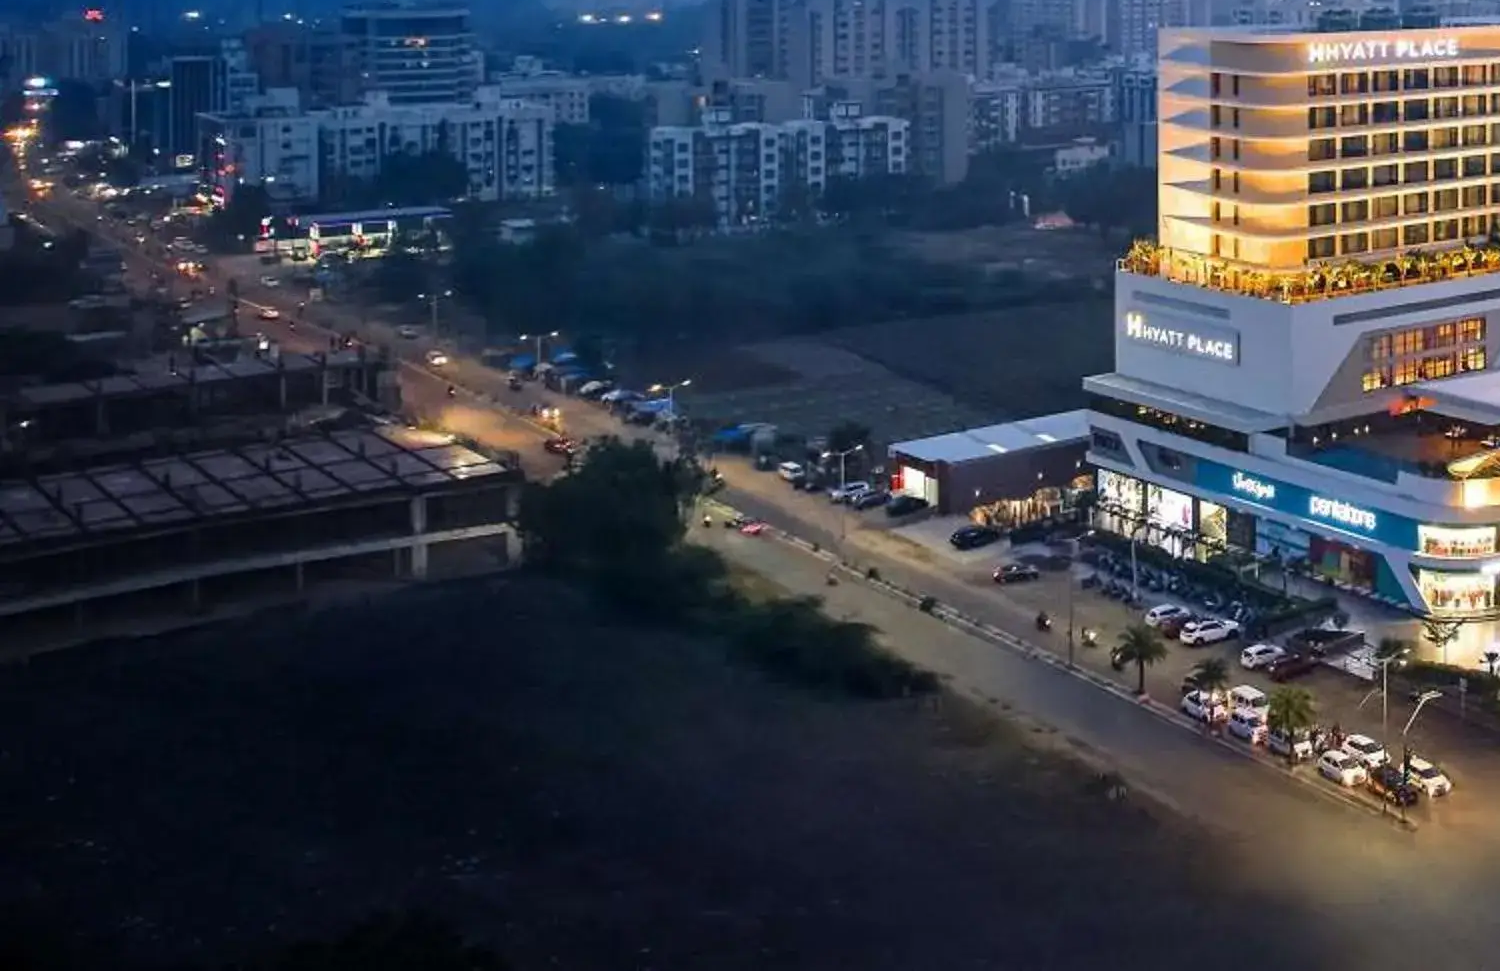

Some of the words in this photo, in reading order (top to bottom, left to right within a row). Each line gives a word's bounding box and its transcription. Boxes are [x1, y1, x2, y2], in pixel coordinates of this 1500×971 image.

[1325, 40, 1389, 61] HYATT
[1395, 37, 1459, 59] PLACE
[1143, 325, 1184, 347] HYATT
[1187, 333, 1233, 360] PLACE
